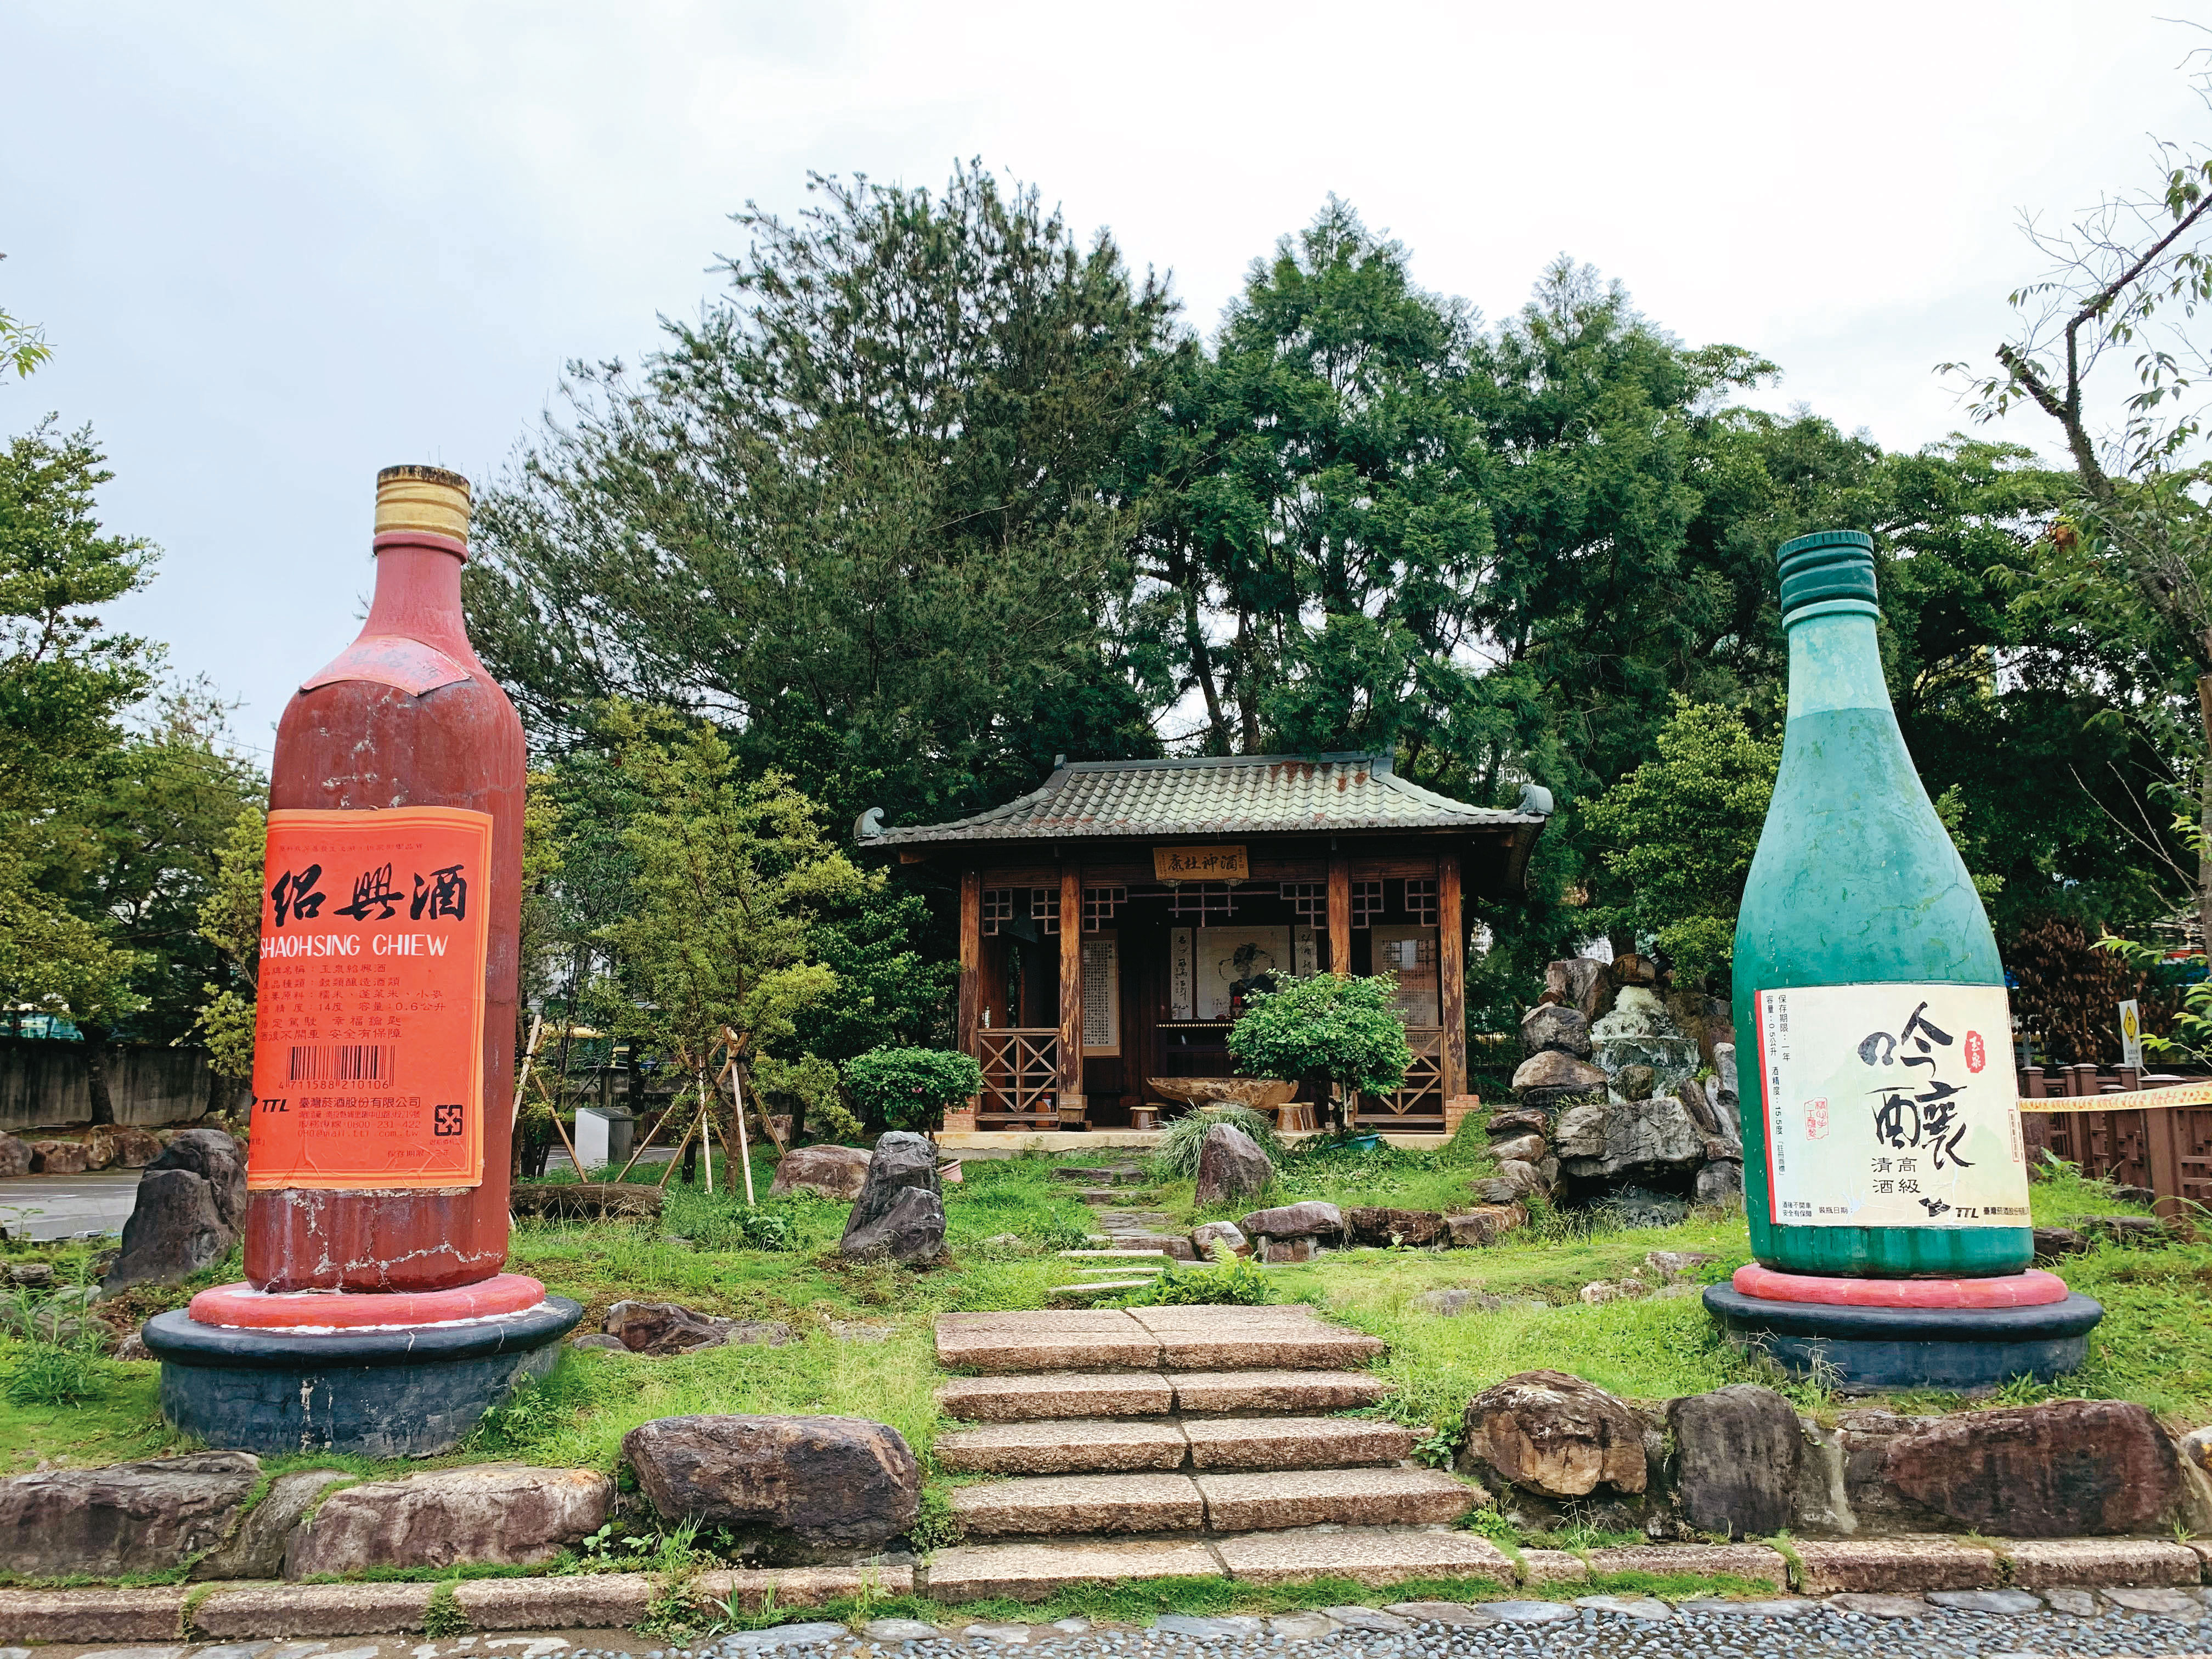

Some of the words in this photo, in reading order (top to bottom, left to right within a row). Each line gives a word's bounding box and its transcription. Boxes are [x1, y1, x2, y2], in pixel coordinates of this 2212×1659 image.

[270, 862, 467, 927] 紹興酒
[260, 934, 360, 960] SHAOHSING
[372, 934, 449, 957] CHIEW
[262, 1099, 290, 1113] TTL
[1955, 1207, 1979, 1218] TTL
